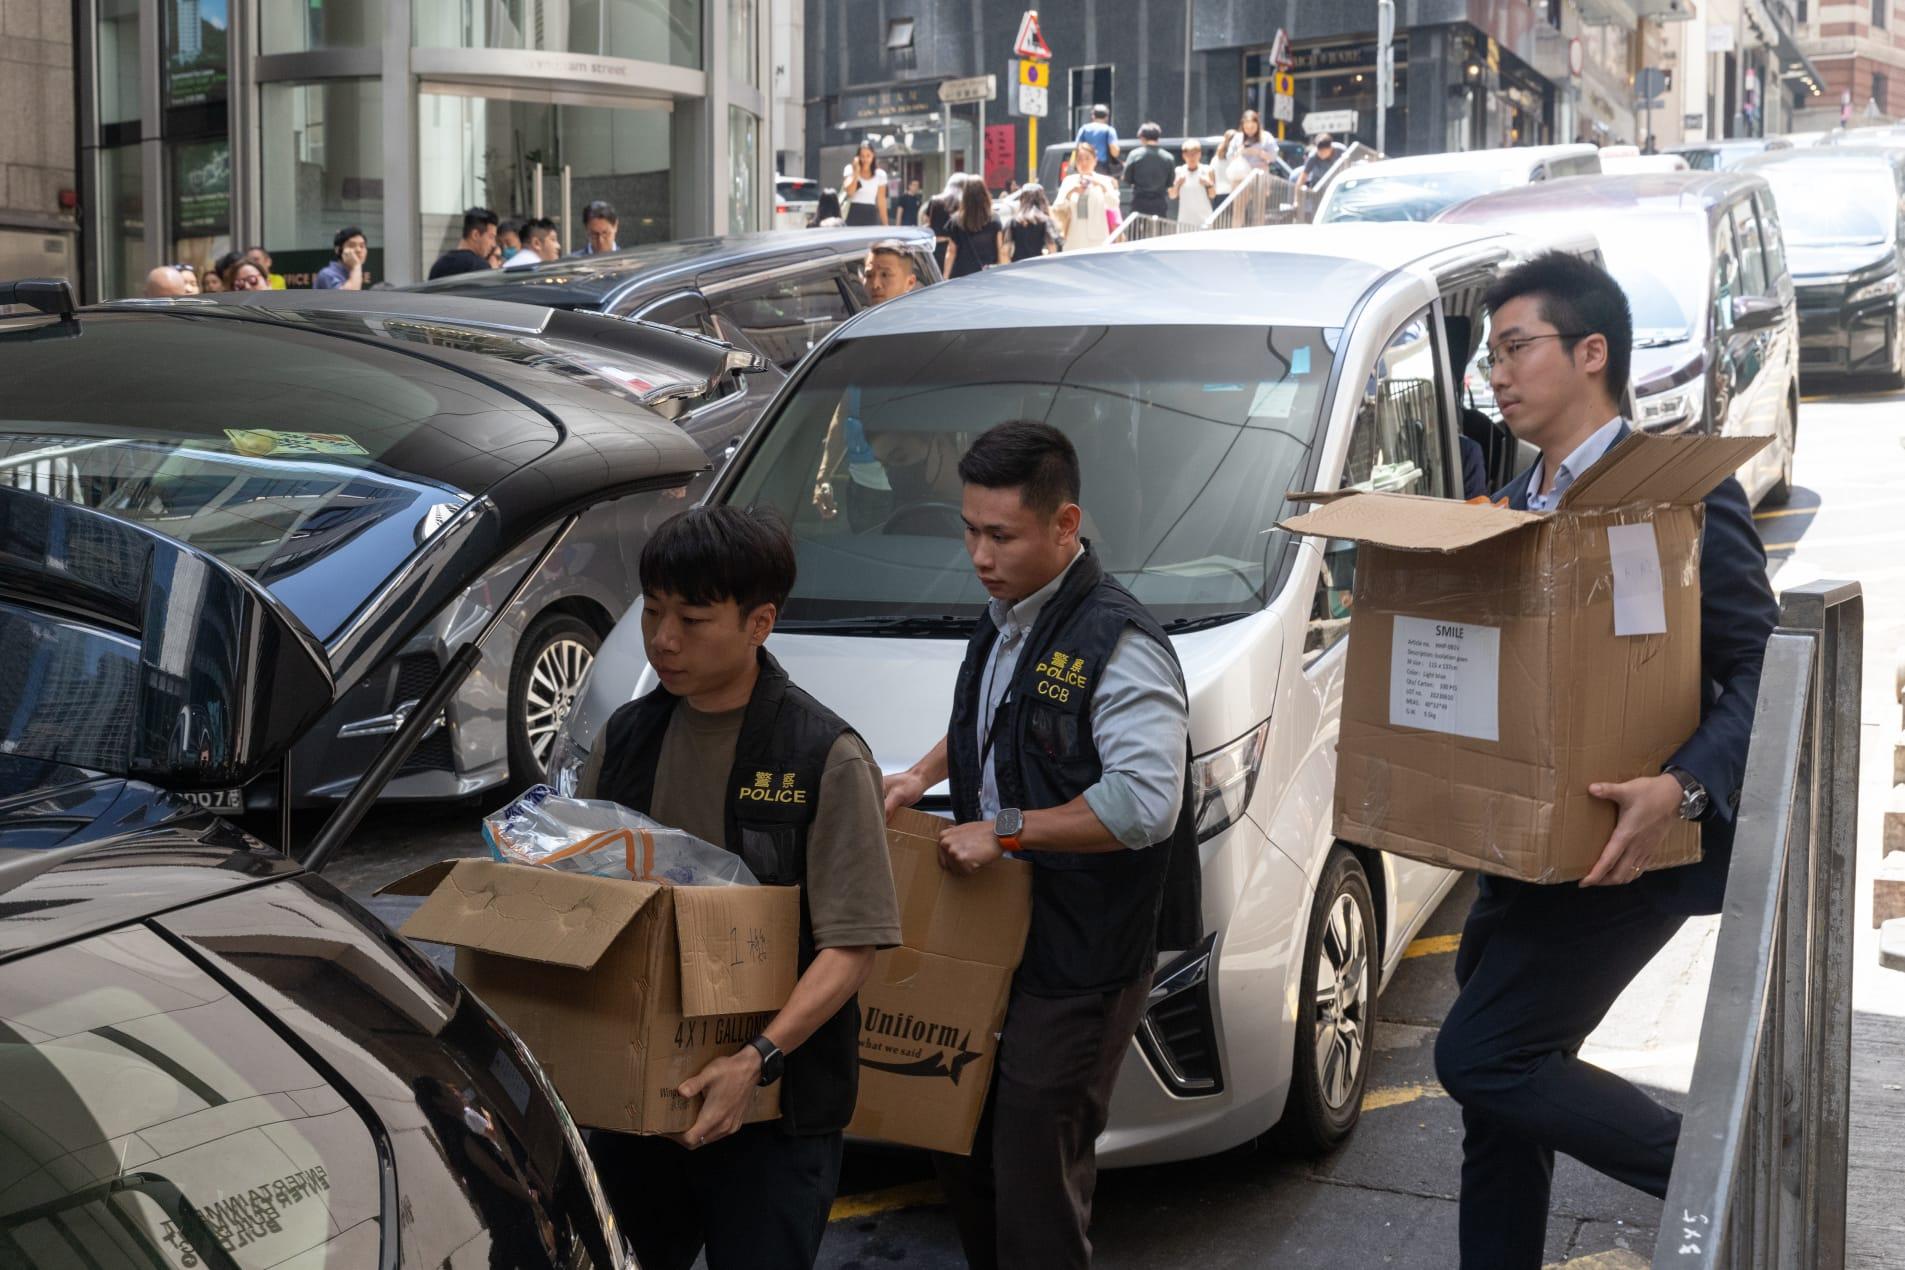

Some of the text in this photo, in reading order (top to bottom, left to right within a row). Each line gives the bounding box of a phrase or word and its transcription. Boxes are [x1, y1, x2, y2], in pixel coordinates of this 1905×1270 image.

[1435, 624, 1464, 639] SMILE
[1035, 662, 1087, 689] POLICE
[1038, 680, 1070, 703] CCB
[739, 787, 807, 804] POLICE
[674, 1021, 683, 1048] 4
[702, 1020, 708, 1046] 1
[864, 1006, 960, 1049] Uniform
[858, 1037, 923, 1059] what we said
